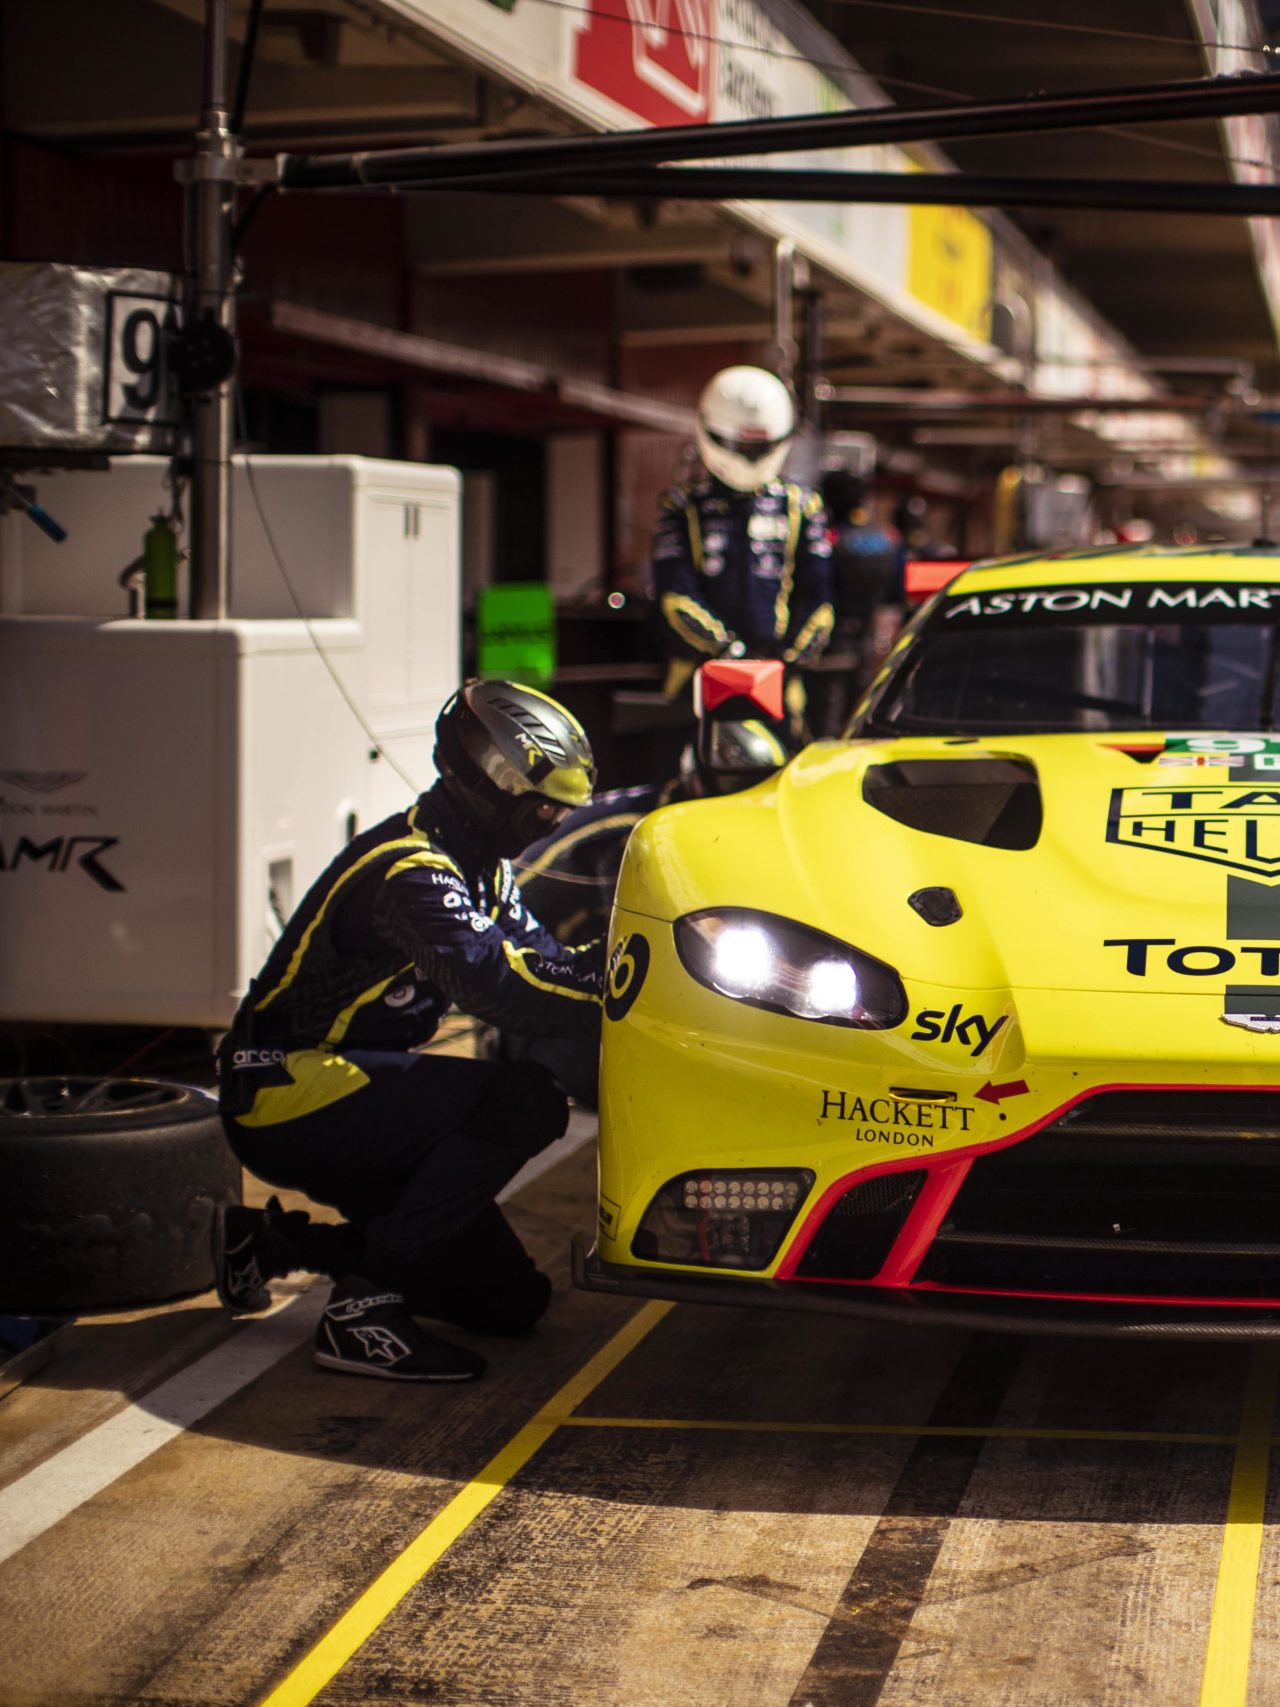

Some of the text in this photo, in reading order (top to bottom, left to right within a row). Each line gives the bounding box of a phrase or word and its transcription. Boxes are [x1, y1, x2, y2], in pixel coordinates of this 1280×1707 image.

[121, 308, 160, 408] 9
[944, 588, 1132, 619] ASTON
[911, 1003, 1009, 1057] sky
[232, 1048, 286, 1069] arco
[820, 1090, 976, 1132] HACKETT
[855, 1128, 935, 1148] LONDON
